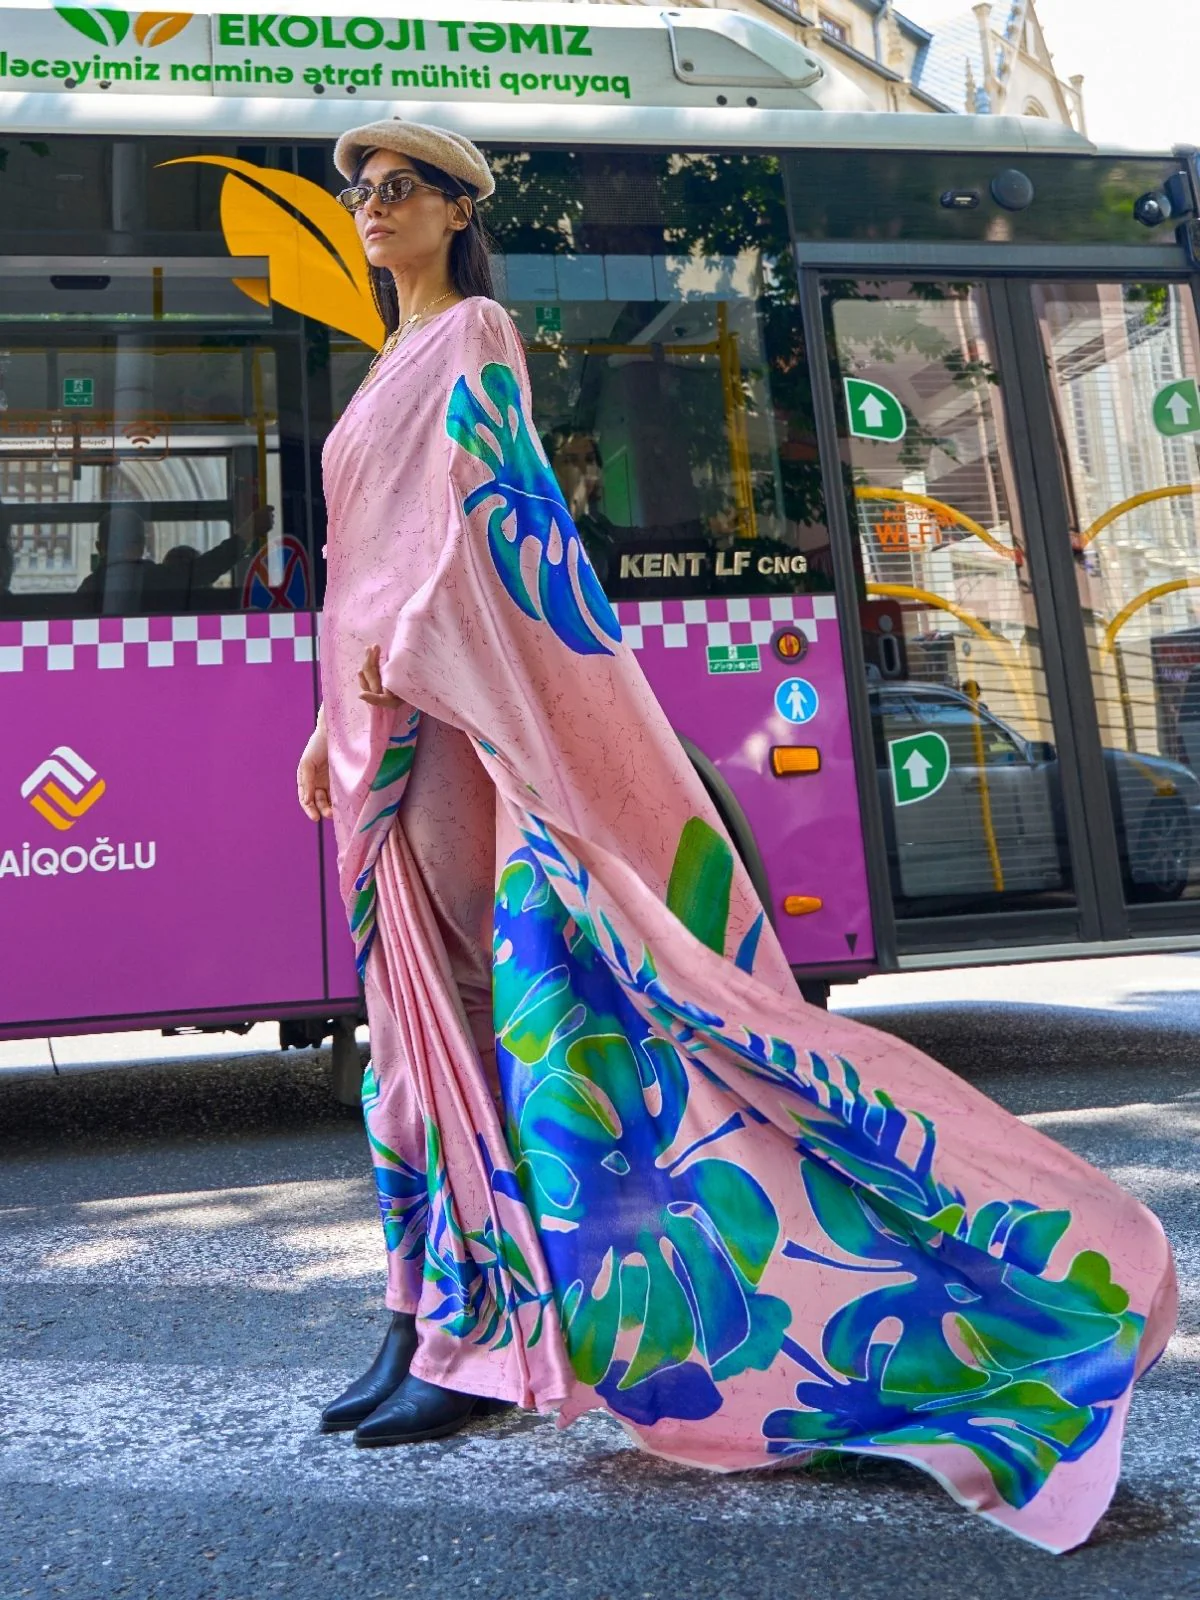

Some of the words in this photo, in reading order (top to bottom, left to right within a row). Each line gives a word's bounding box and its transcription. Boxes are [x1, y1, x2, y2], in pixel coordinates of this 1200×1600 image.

[0, 52, 161, 84] ləcəyimiz
[170, 59, 294, 84] naminə
[303, 63, 383, 86] ətraf
[392, 64, 491, 88] mühiti
[500, 72, 631, 99] qoruyaq
[620, 552, 706, 579] KENT
[715, 551, 751, 576] LF
[757, 555, 808, 575] CNG
